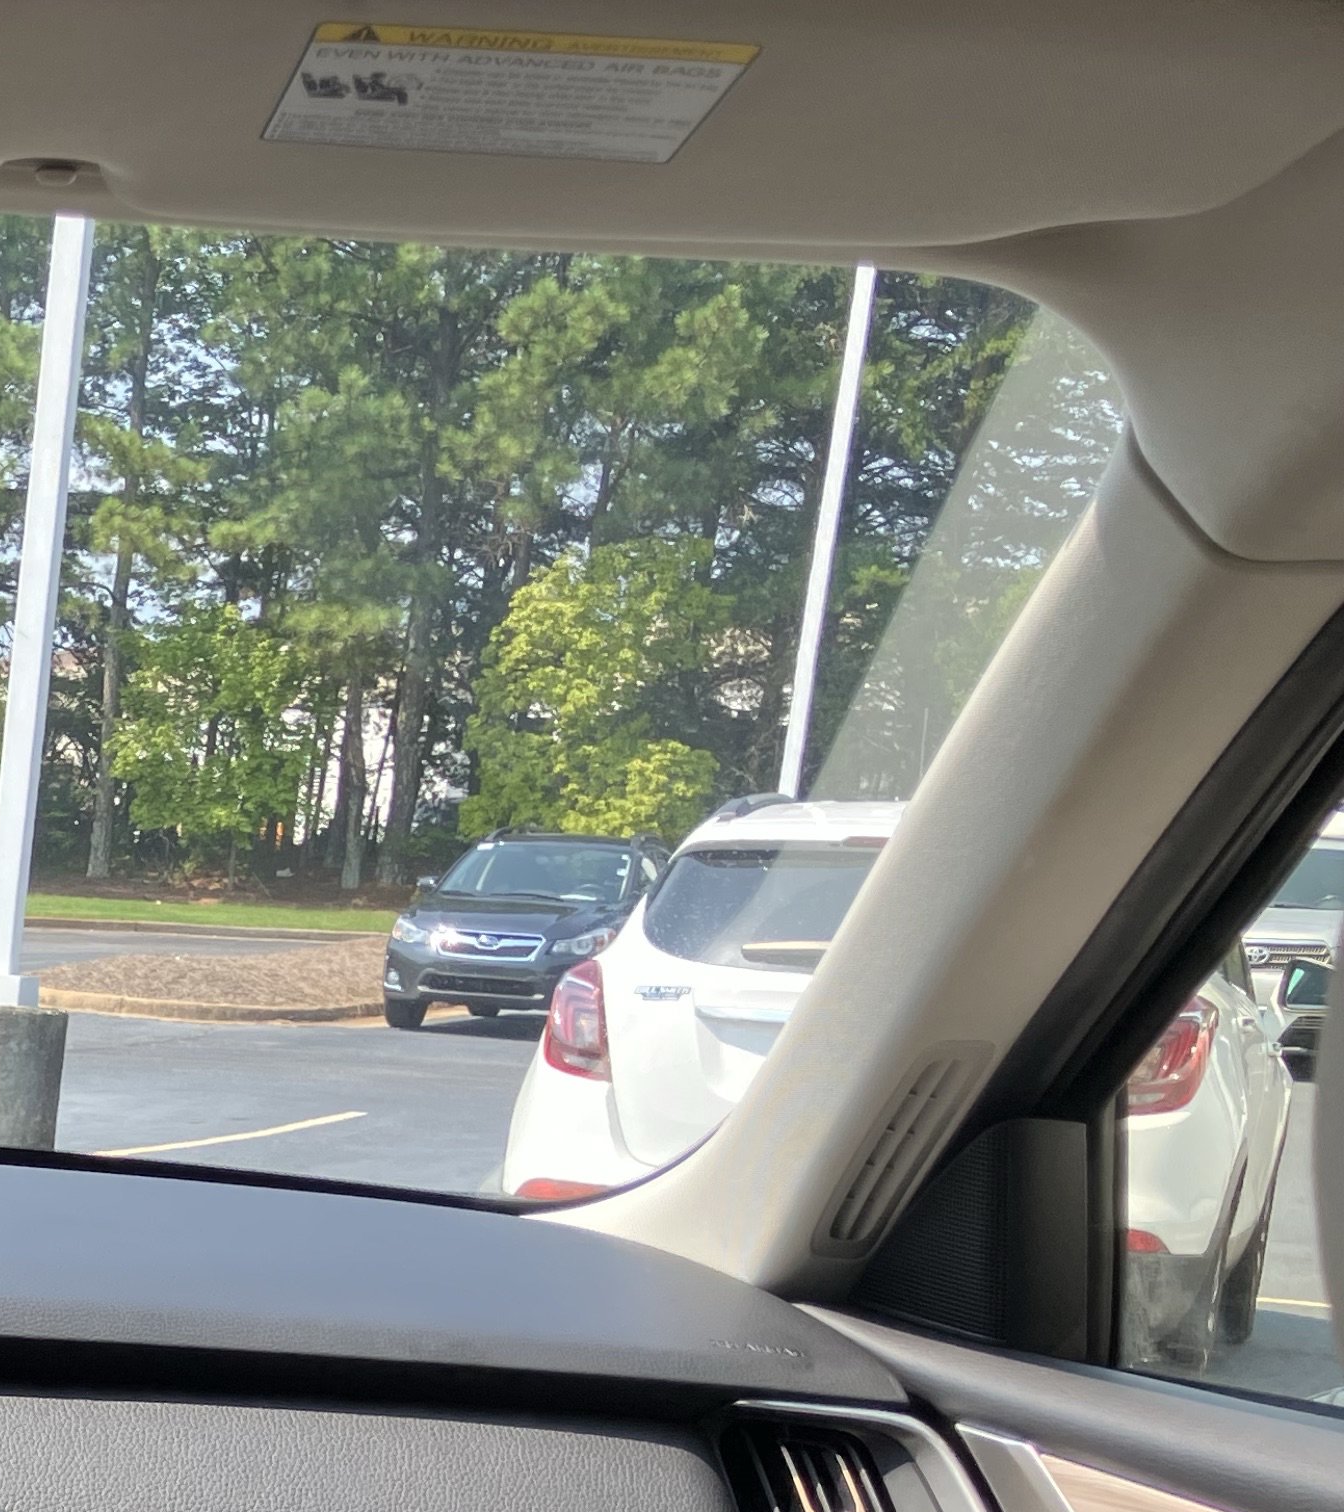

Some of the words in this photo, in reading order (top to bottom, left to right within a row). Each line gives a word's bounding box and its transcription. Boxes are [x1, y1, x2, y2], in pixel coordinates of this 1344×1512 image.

[406, 29, 553, 52] WARNING
[315, 46, 382, 60] EVEN
[387, 48, 452, 64] WITH
[455, 54, 597, 73] ADVANCED
[606, 60, 651, 76] AIR
[652, 63, 723, 80] BAGS
